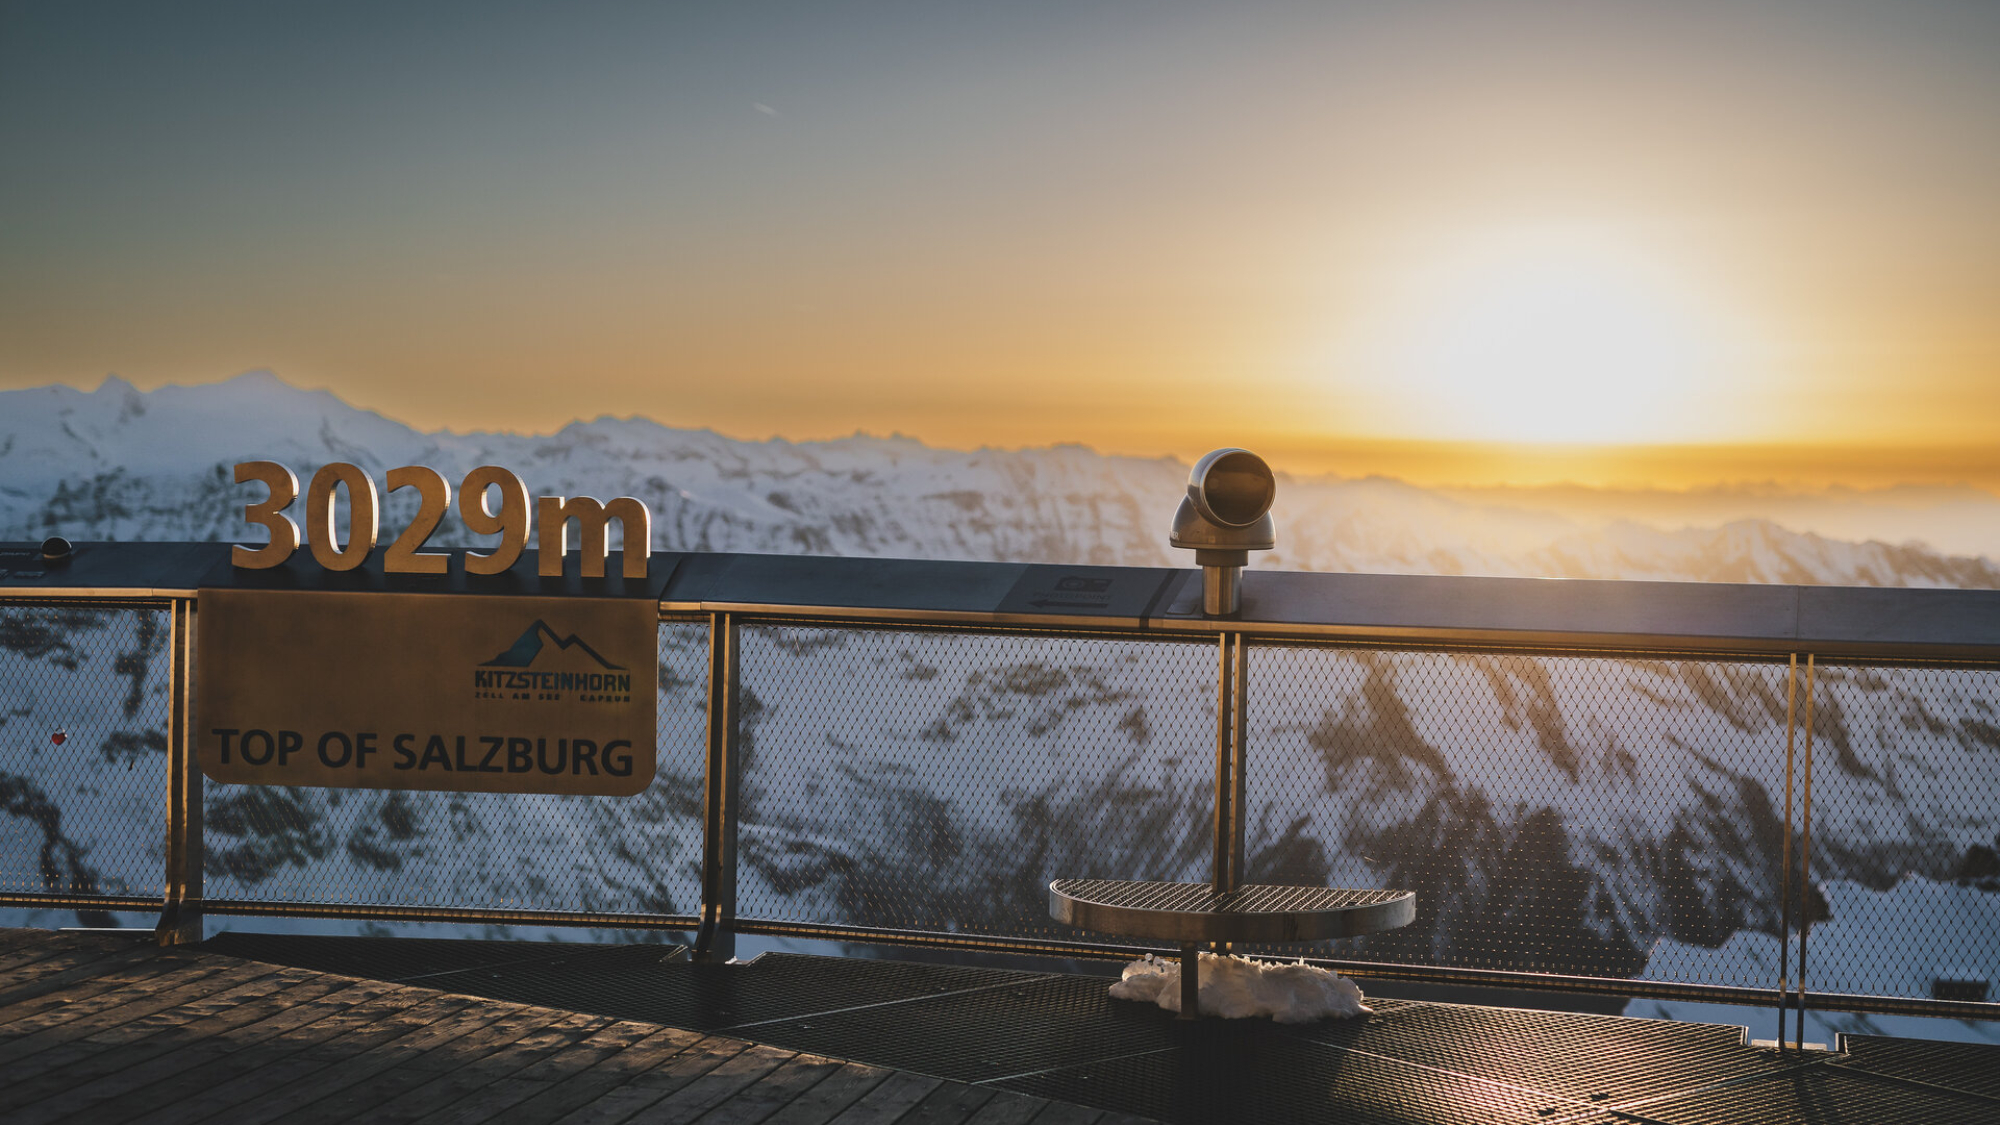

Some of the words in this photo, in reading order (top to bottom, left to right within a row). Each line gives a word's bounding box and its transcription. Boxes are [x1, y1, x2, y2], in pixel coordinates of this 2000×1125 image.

[231, 460, 652, 579] 3029m
[475, 670, 631, 692] KITZSTEINHORN
[212, 728, 304, 767] TOP
[317, 730, 379, 769] OF
[393, 733, 634, 778] SALZBURG
